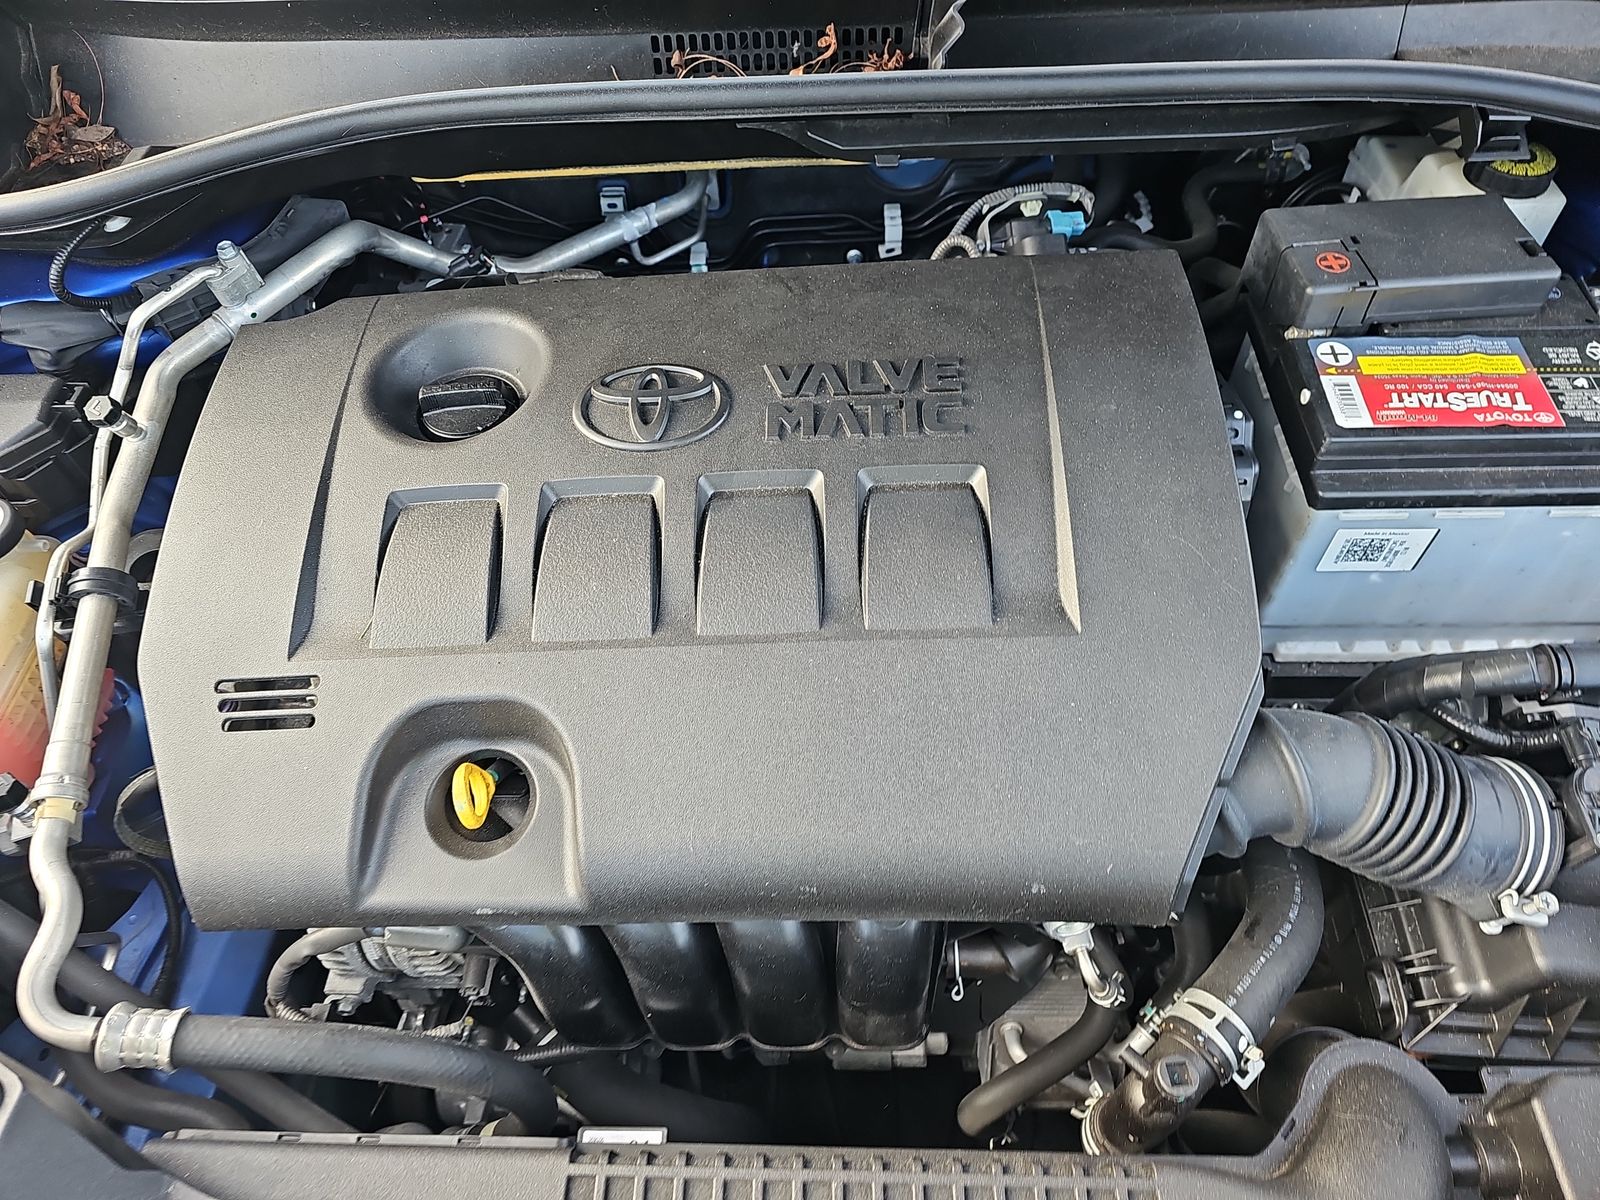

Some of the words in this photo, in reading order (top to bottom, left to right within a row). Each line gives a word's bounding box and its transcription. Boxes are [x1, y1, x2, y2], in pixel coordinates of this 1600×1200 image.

[763, 354, 963, 398] VALVE
[765, 399, 966, 442] MATIC
[1473, 410, 1533, 423] TOYOTA
